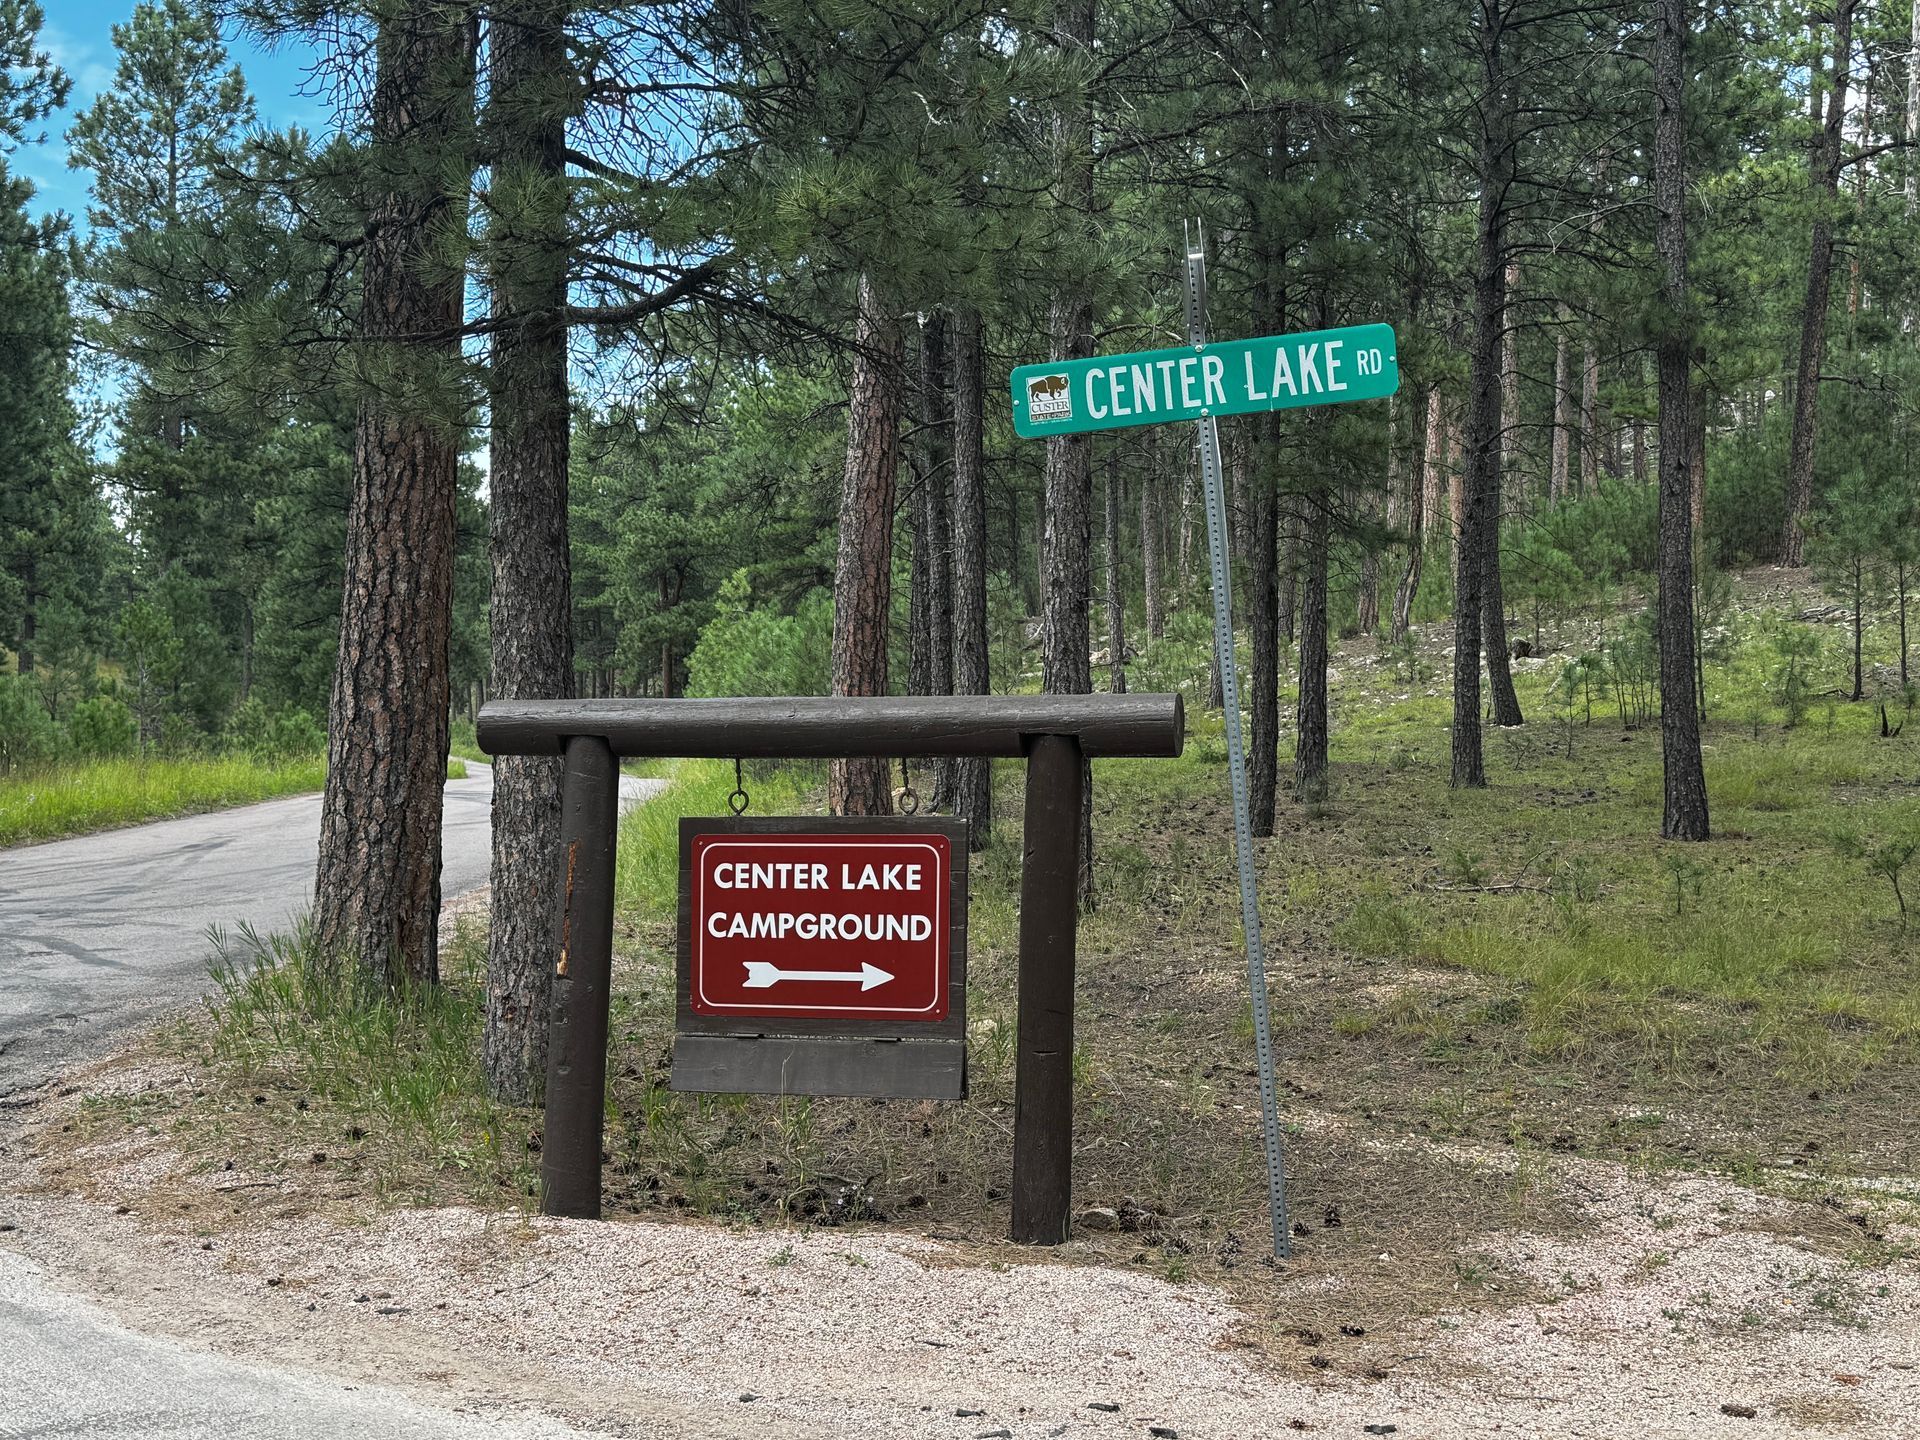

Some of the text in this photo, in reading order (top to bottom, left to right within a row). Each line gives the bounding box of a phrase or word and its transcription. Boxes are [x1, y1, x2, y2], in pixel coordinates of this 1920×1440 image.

[1086, 341, 1382, 419] CENTER LAKE RD
[1032, 401, 1069, 413] CUSTER
[713, 863, 922, 891] CENTER LAKE
[707, 912, 932, 941] CAMPGROUND
